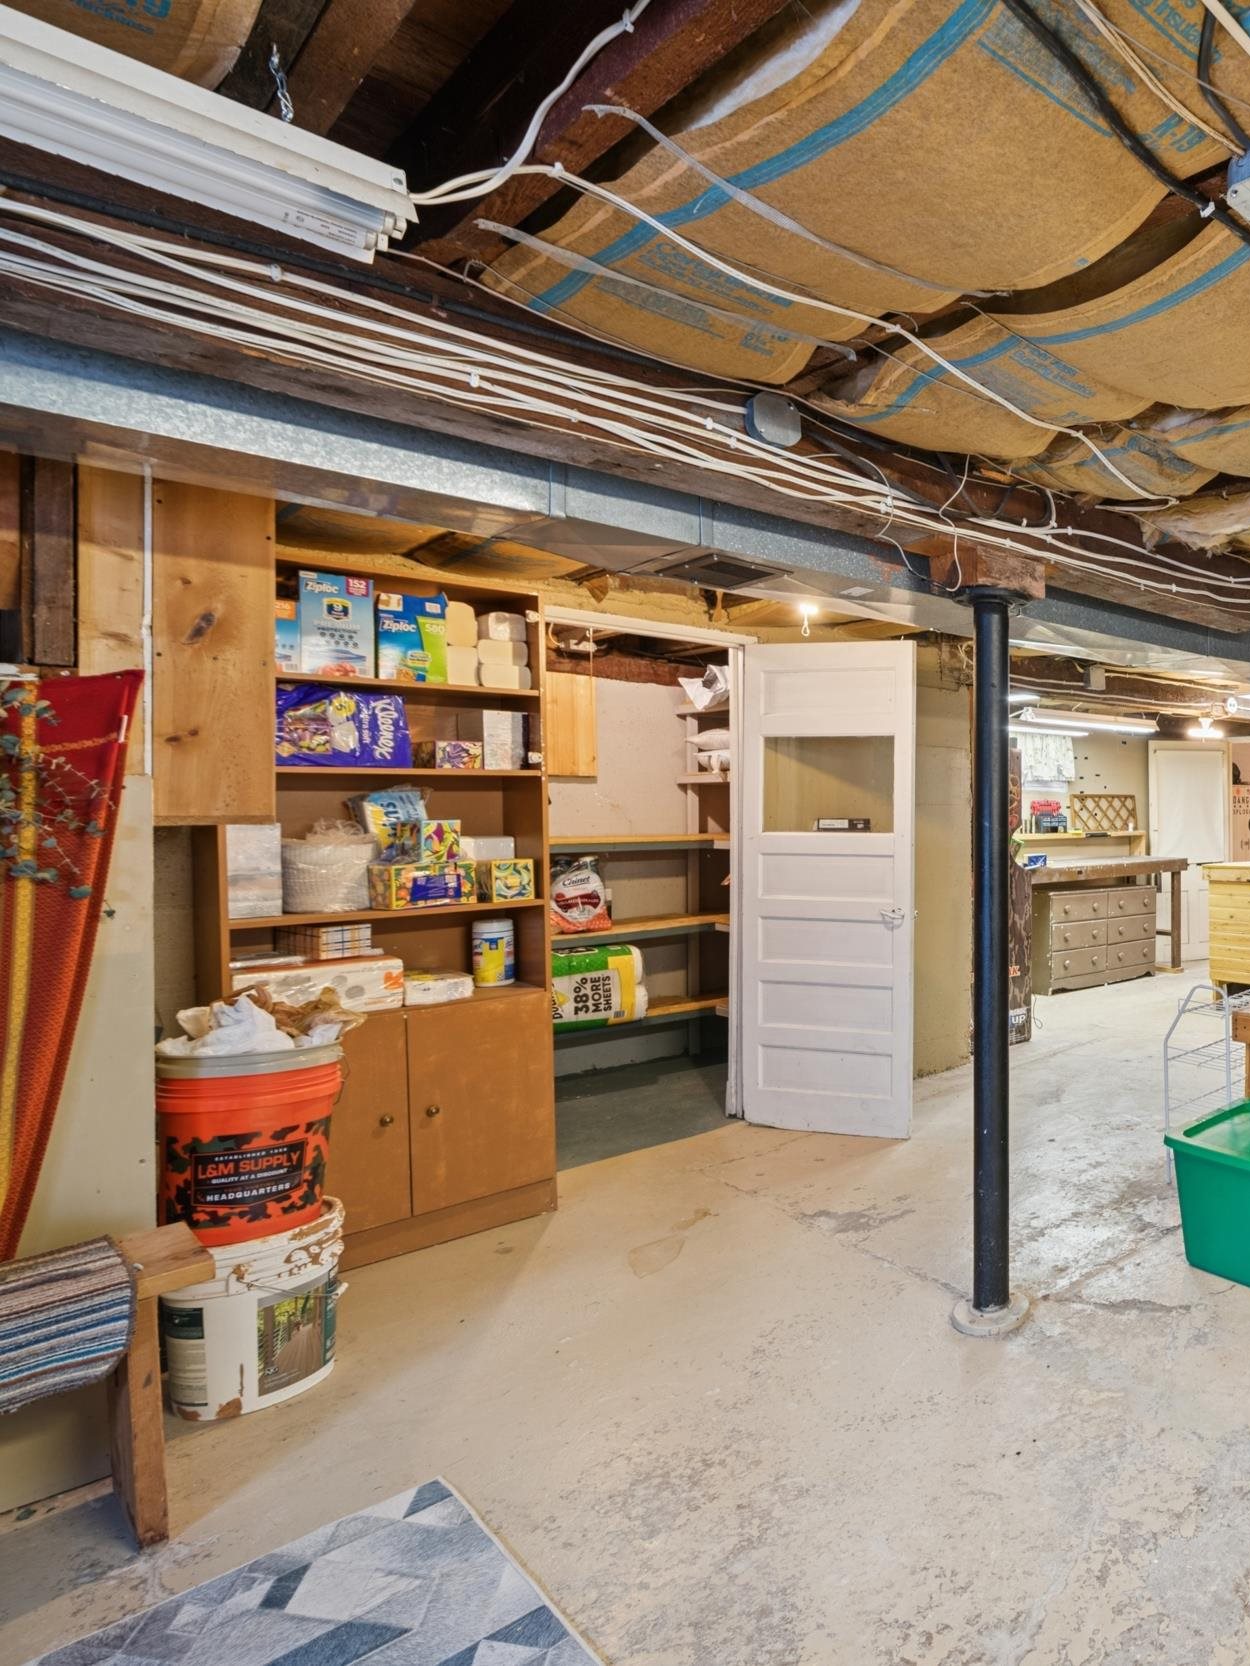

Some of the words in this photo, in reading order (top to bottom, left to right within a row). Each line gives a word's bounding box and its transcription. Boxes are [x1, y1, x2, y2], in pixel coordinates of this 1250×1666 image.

[306, 581, 339, 594] Ziploc
[348, 579, 368, 589] 152
[382, 620, 417, 633] Ziploc
[371, 699, 395, 760] Kleenex
[562, 876, 592, 887] Chinet
[574, 977, 589, 1015] 38%
[591, 976, 602, 1012] MORE
[602, 975, 612, 1011] SHEETS
[1012, 1015, 1026, 1025] UP
[197, 1161, 234, 1180] L&M
[239, 1151, 301, 1172] SUPPLY
[211, 1176, 238, 1185] QUALITY
[256, 1168, 288, 1178] DISCOUNT
[206, 1182, 290, 1202] HEADQUARTERS
